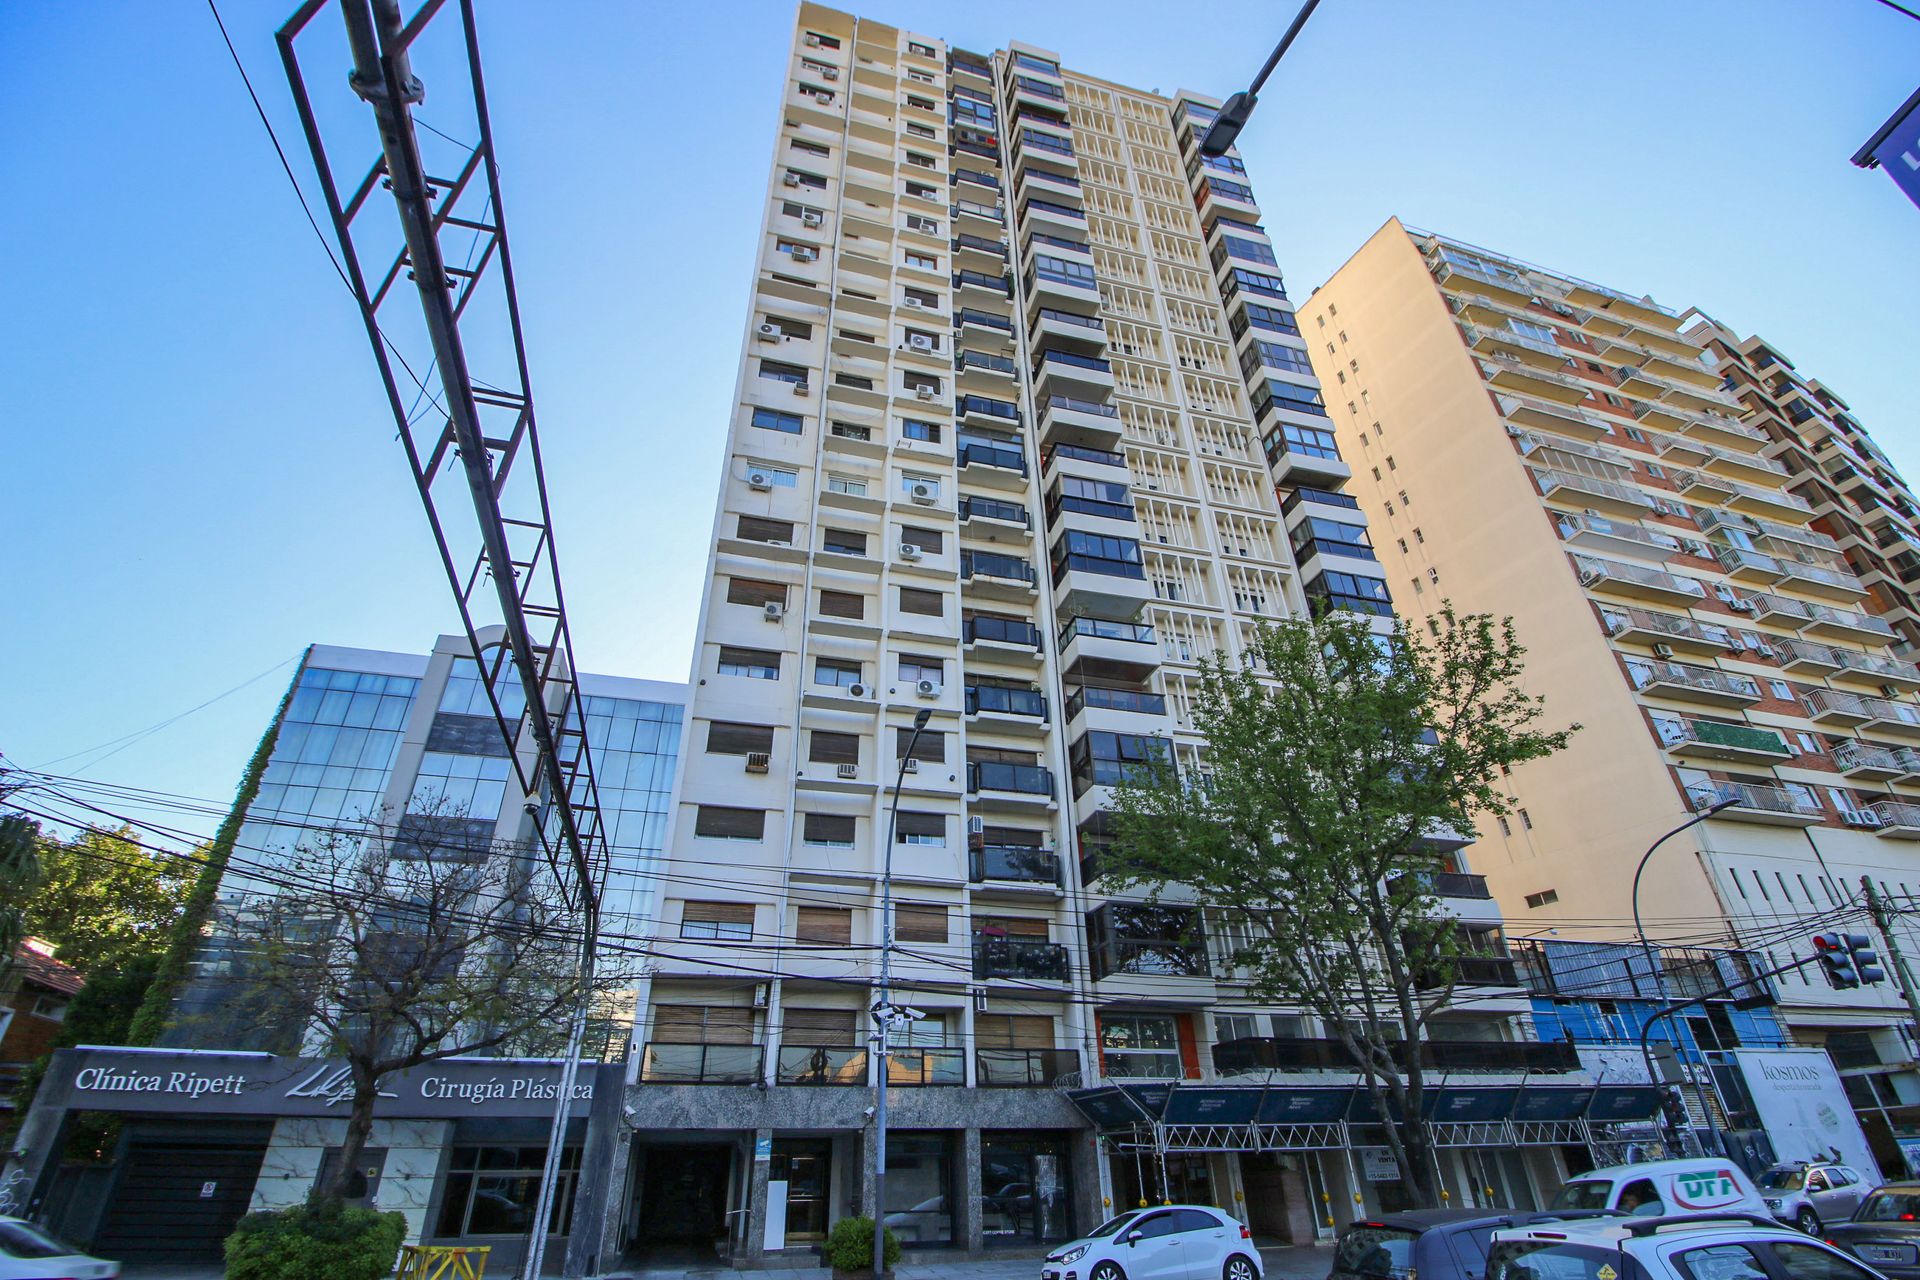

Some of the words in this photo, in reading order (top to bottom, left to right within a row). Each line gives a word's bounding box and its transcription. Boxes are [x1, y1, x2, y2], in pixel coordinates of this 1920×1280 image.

[75, 1067, 162, 1092] Clínica
[165, 1071, 246, 1098] Ripett
[1758, 1058, 1819, 1081] kosmos
[420, 1077, 505, 1104] Cirugía
